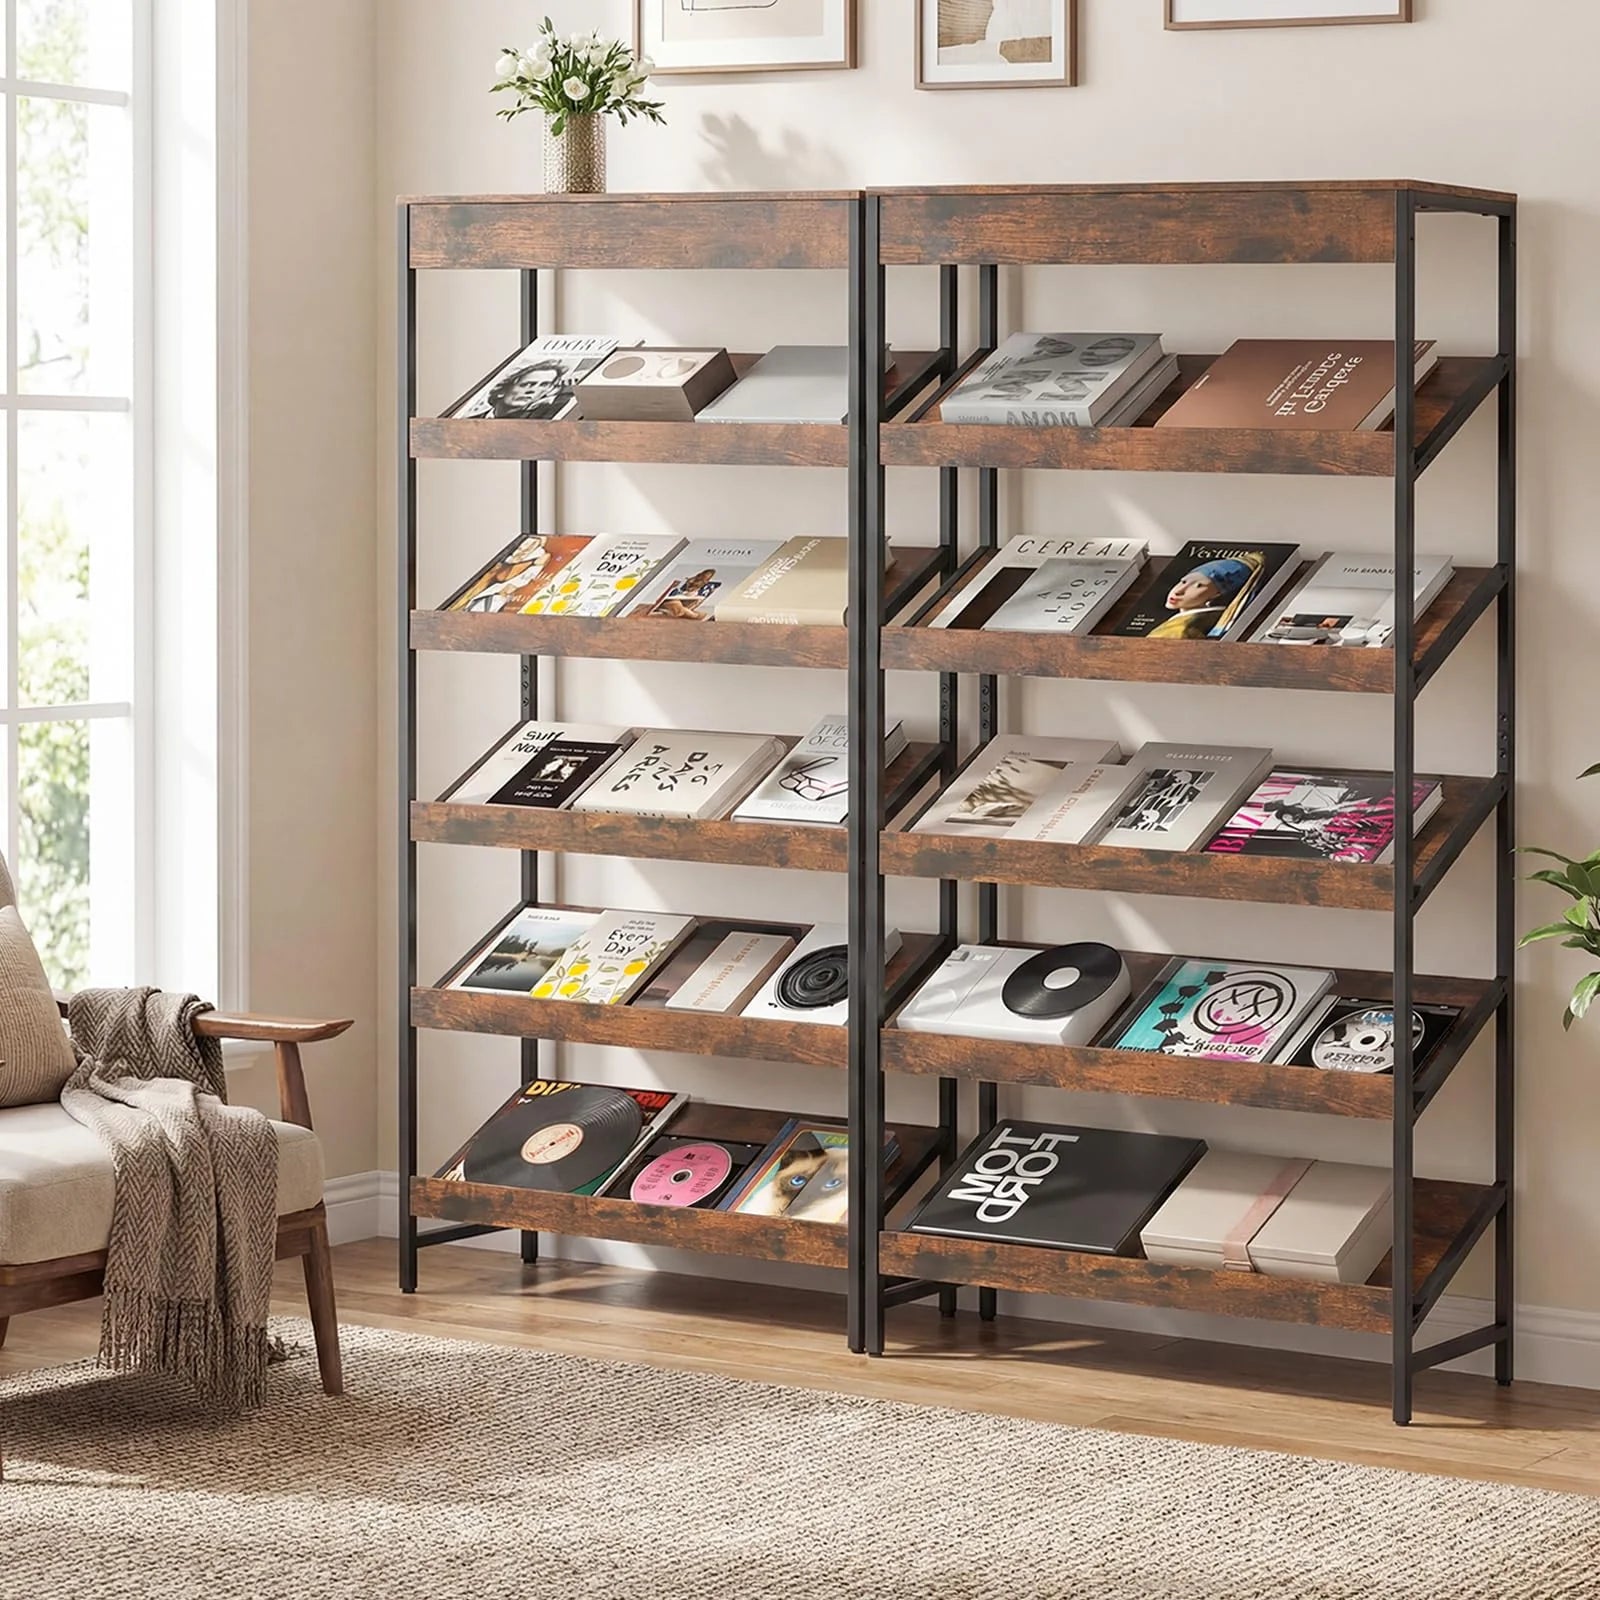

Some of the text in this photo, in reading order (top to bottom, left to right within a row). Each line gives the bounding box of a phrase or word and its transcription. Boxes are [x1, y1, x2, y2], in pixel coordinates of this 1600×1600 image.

[601, 549, 645, 564] Every
[1017, 539, 1133, 557] CEREAL
[596, 561, 628, 573] Day
[1058, 570, 1118, 624] ROSSI
[611, 745, 670, 793] ARLES
[657, 752, 708, 792] DAYS
[608, 929, 654, 945] Every
[604, 942, 636, 957] Day
